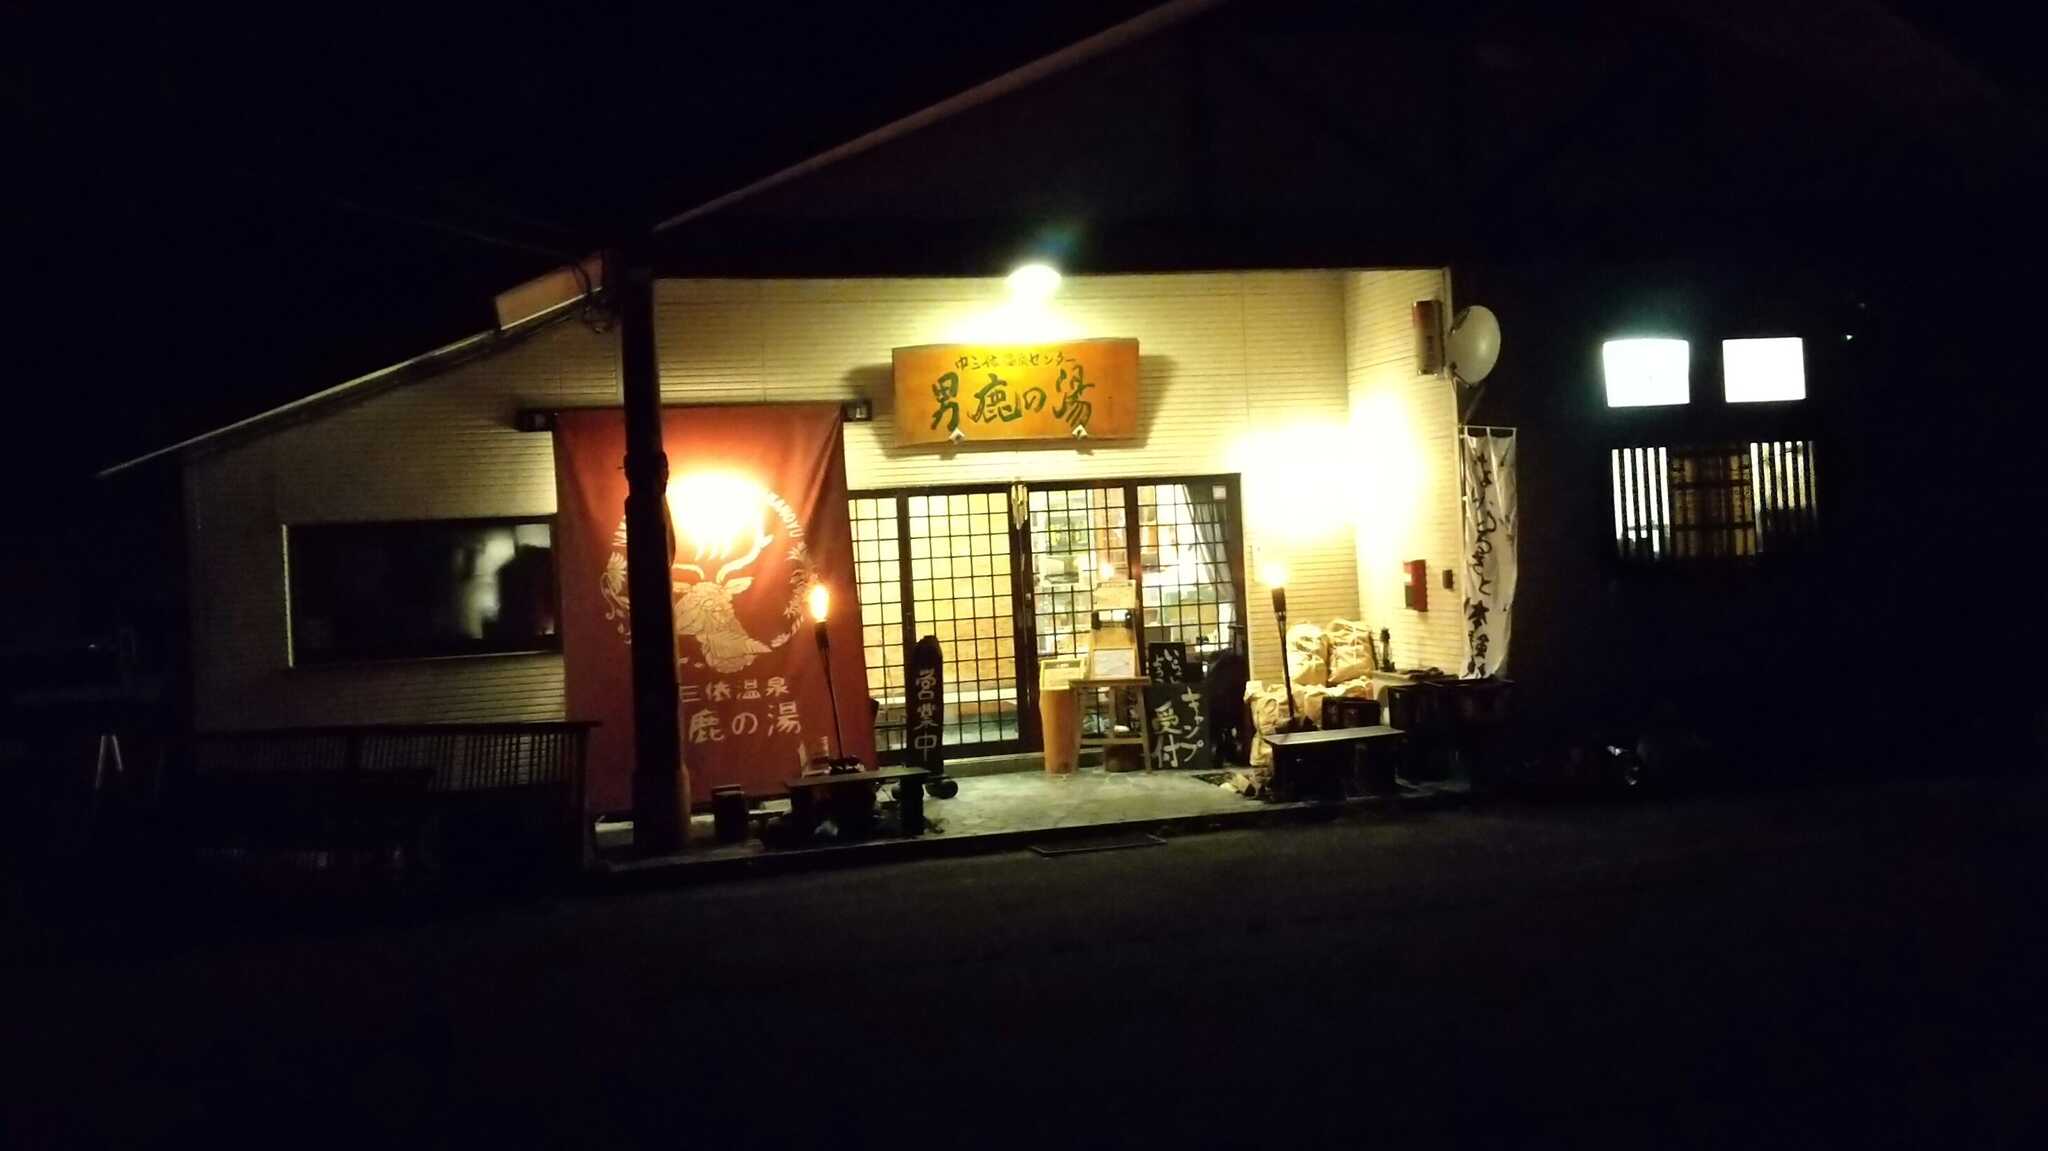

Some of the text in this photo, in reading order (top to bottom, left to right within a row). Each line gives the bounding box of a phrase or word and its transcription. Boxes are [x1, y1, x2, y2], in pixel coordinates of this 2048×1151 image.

[931, 365, 1095, 433] 男鹿の湯
[679, 676, 790, 703] 三依温泉
[914, 668, 939, 761] 営業中
[687, 701, 801, 744] 鹿の湯
